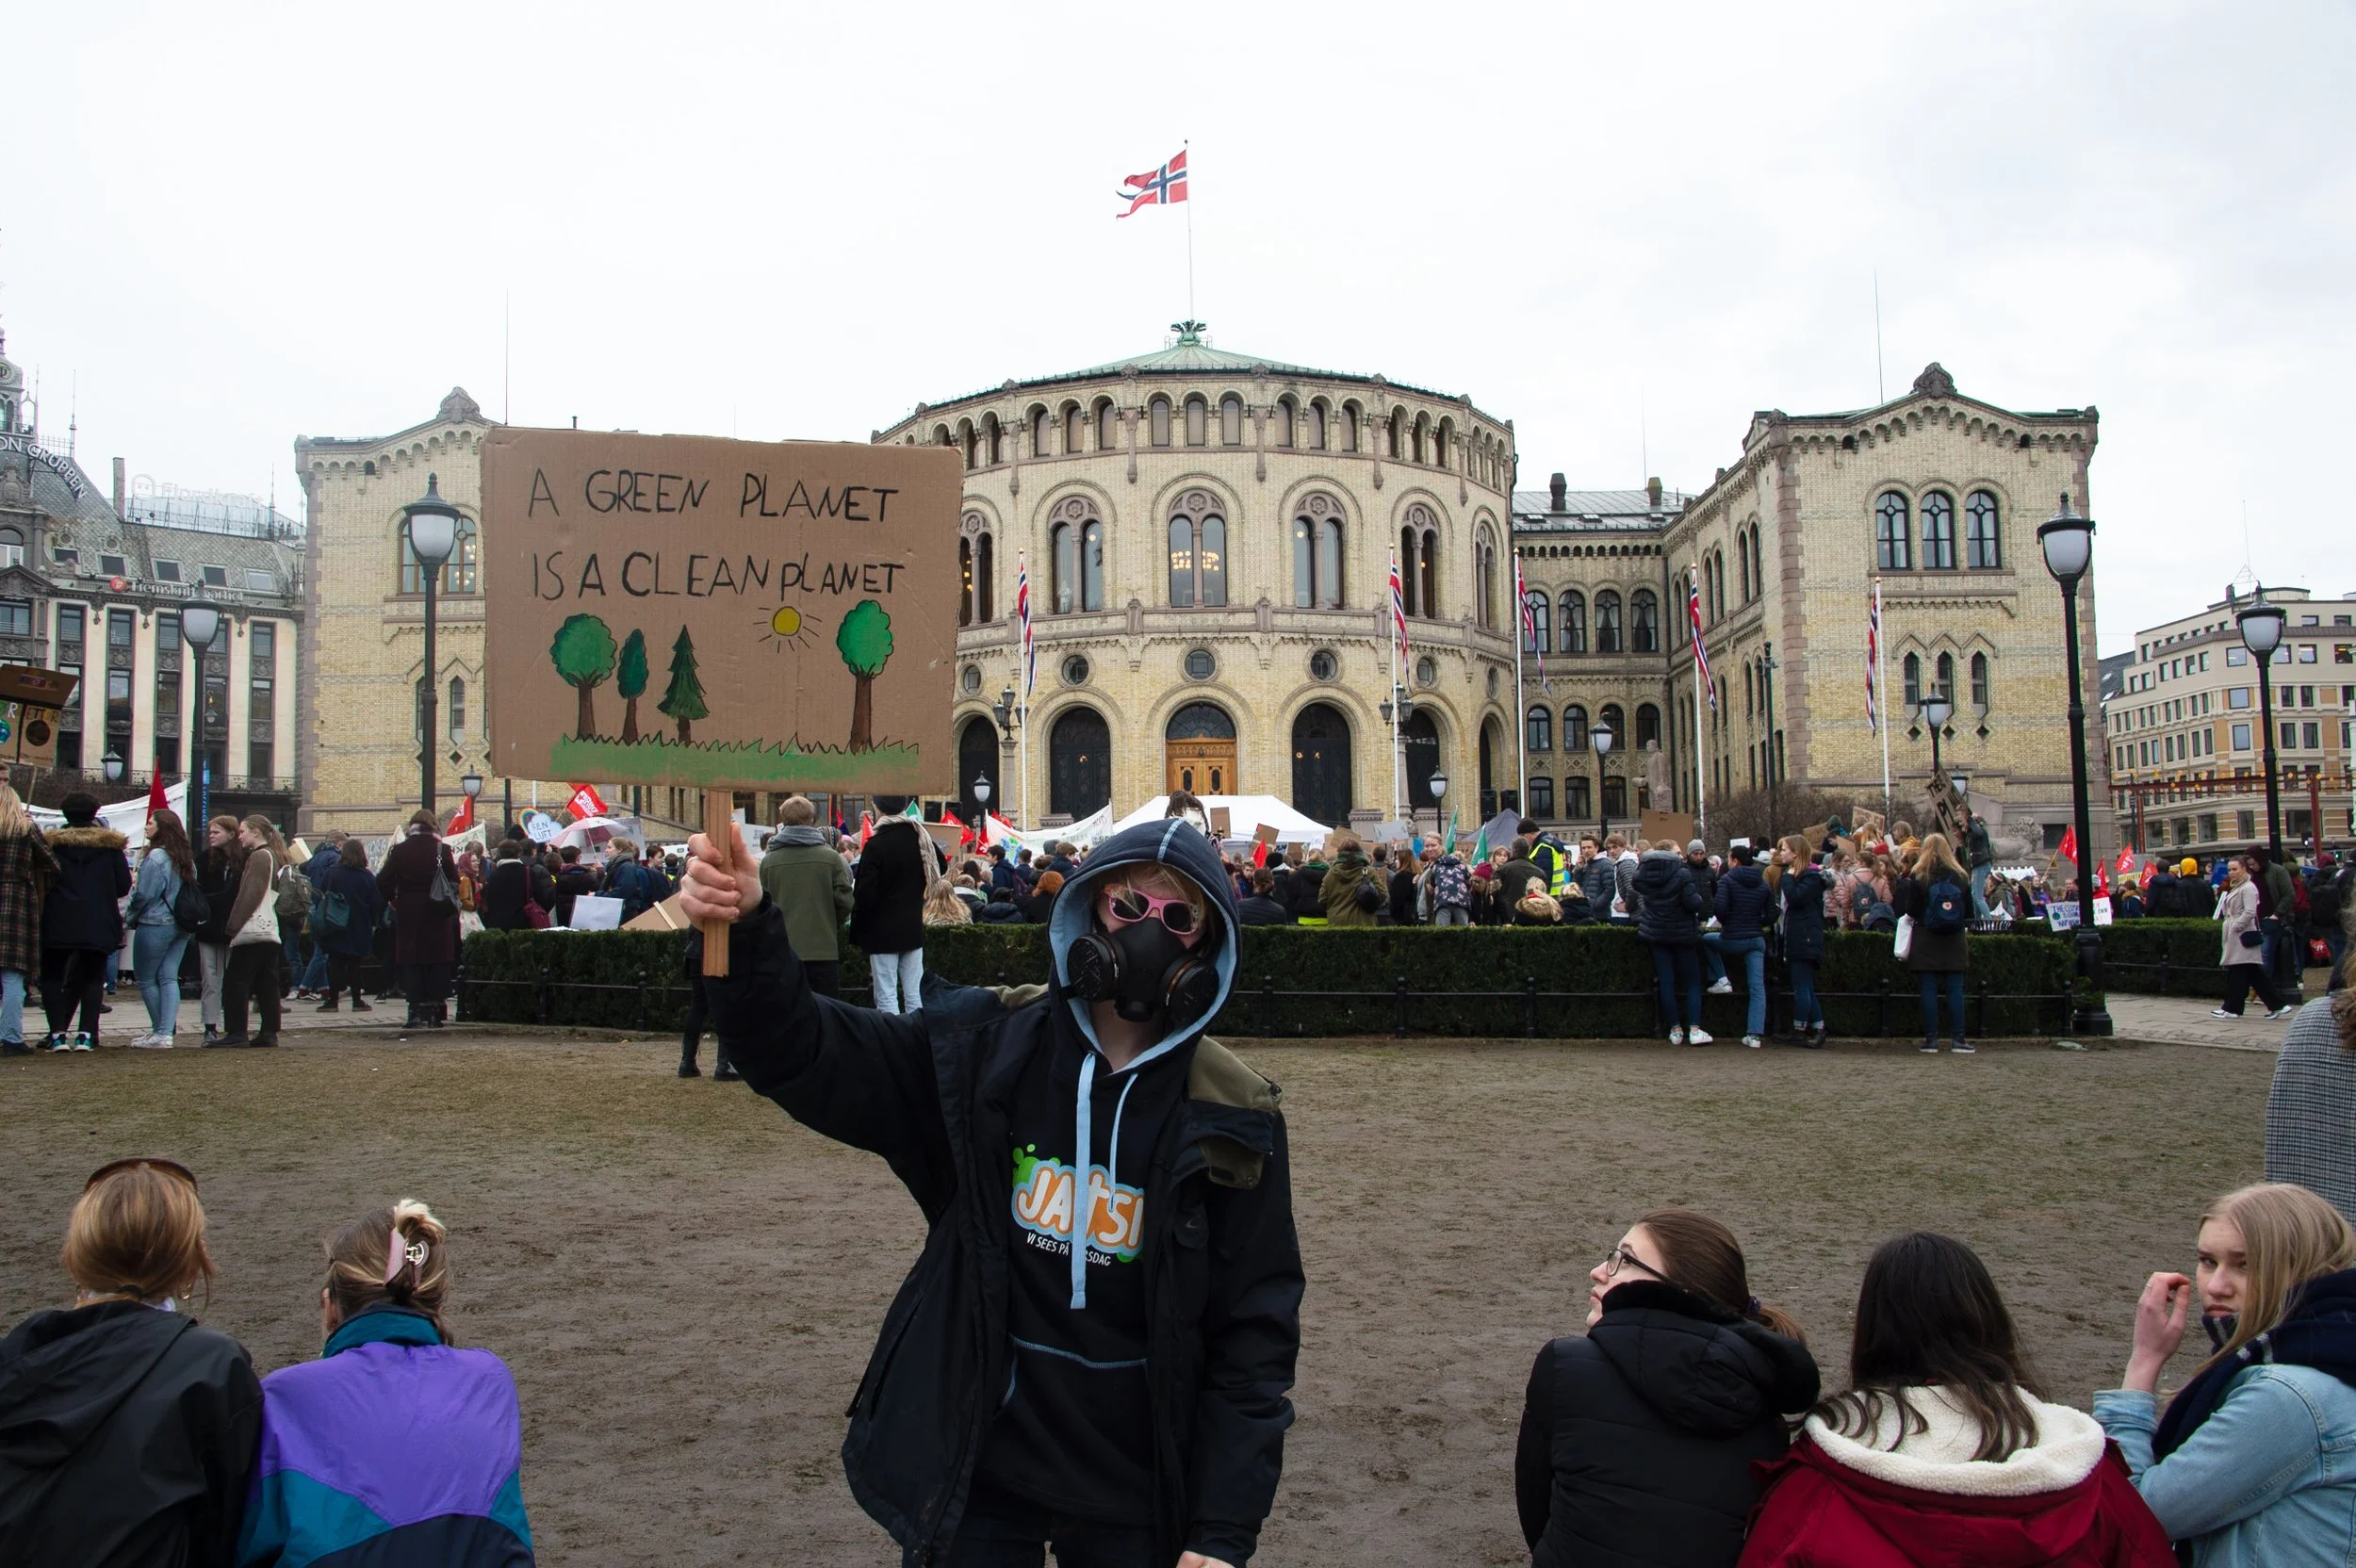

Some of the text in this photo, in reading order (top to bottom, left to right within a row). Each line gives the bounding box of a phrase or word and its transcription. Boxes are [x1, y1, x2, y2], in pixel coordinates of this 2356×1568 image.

[27, 443, 89, 498] GRUPPEN
[529, 468, 899, 521] A GREEN PLANET
[533, 551, 565, 600] IS
[579, 552, 607, 598] A
[621, 551, 769, 597] CLEAN
[1026, 1232, 1037, 1244] VI
[1036, 1236, 1057, 1252] SEES
[1058, 1241, 1071, 1256] PÅ
